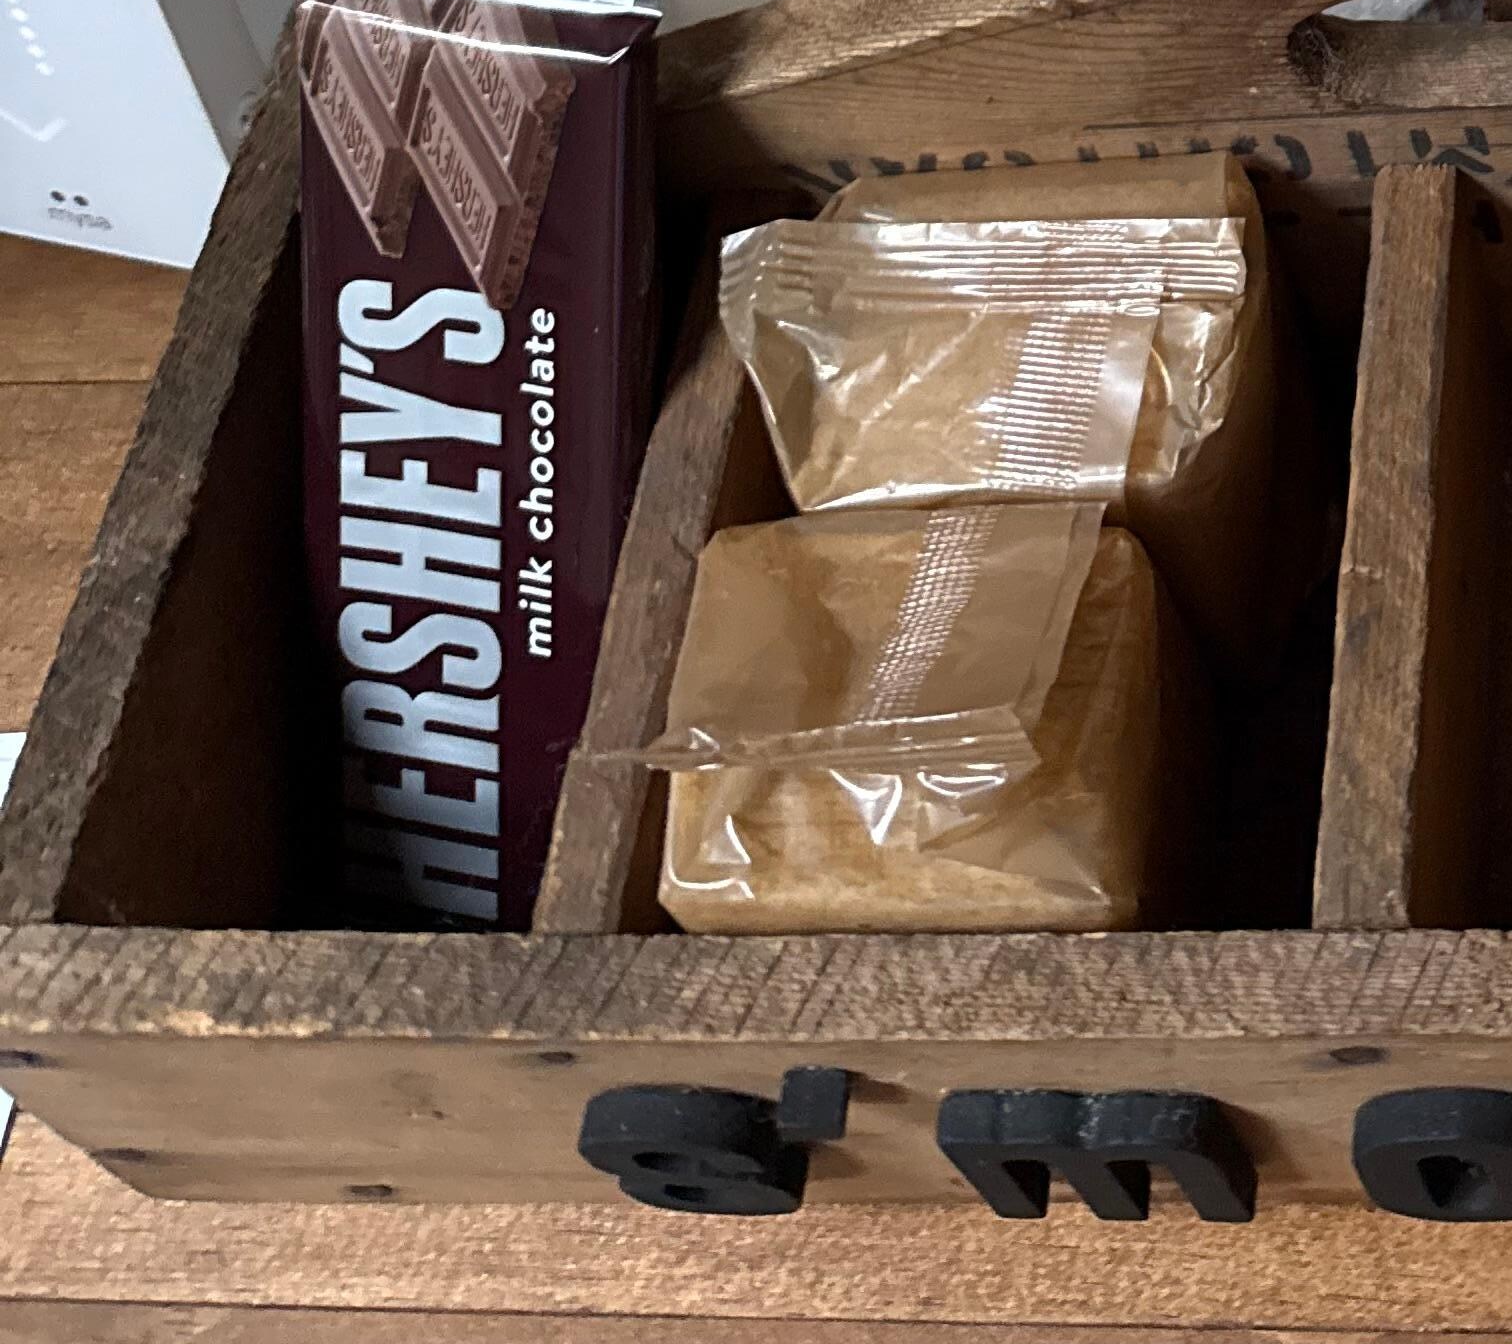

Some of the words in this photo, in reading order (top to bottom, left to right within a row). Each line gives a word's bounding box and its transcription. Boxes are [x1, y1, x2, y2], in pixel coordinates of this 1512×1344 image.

[519, 307, 556, 544] chocolate
[338, 278, 504, 923] HERSHEY'S
[519, 556, 553, 659] milk
